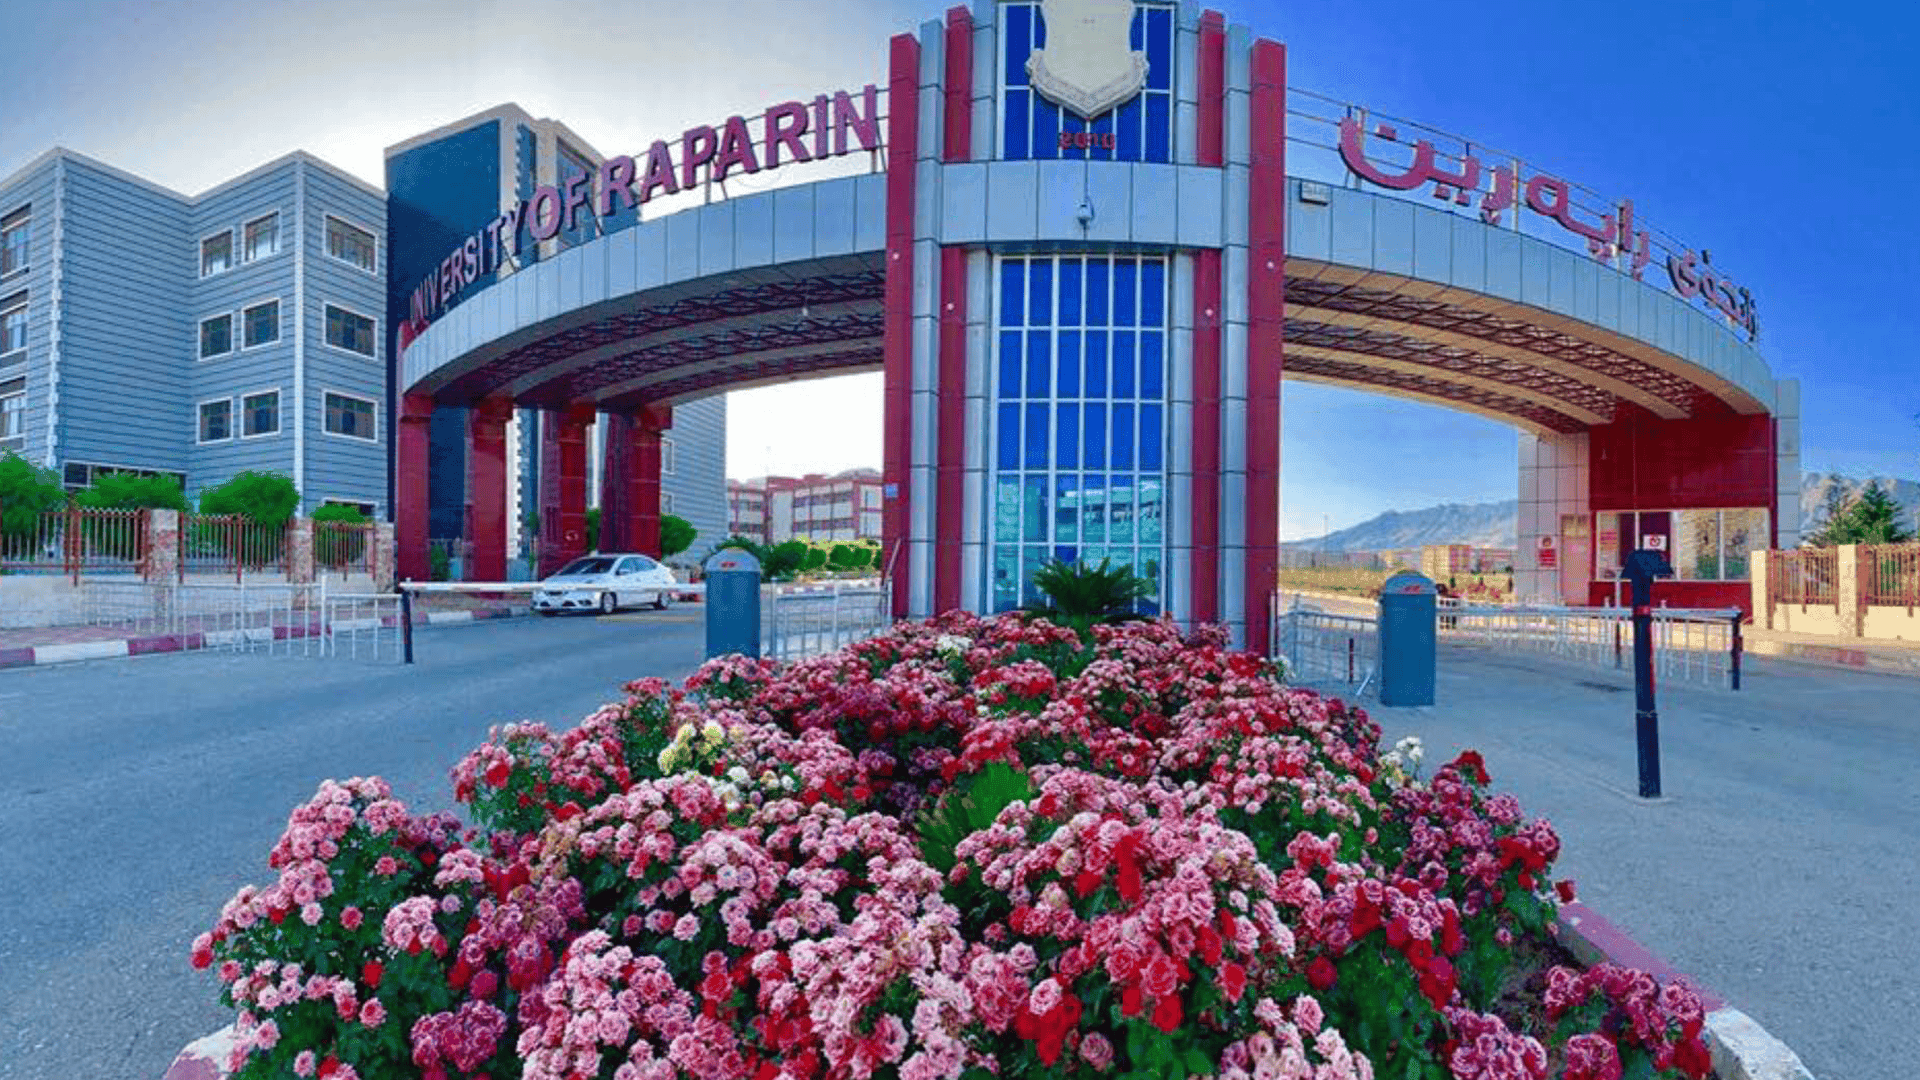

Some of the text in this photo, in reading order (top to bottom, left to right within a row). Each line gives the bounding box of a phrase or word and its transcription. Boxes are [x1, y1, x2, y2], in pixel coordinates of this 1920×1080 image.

[1059, 132, 1116, 150] 2010
[410, 84, 879, 331] UNIVERSITY OF RAPARIN
